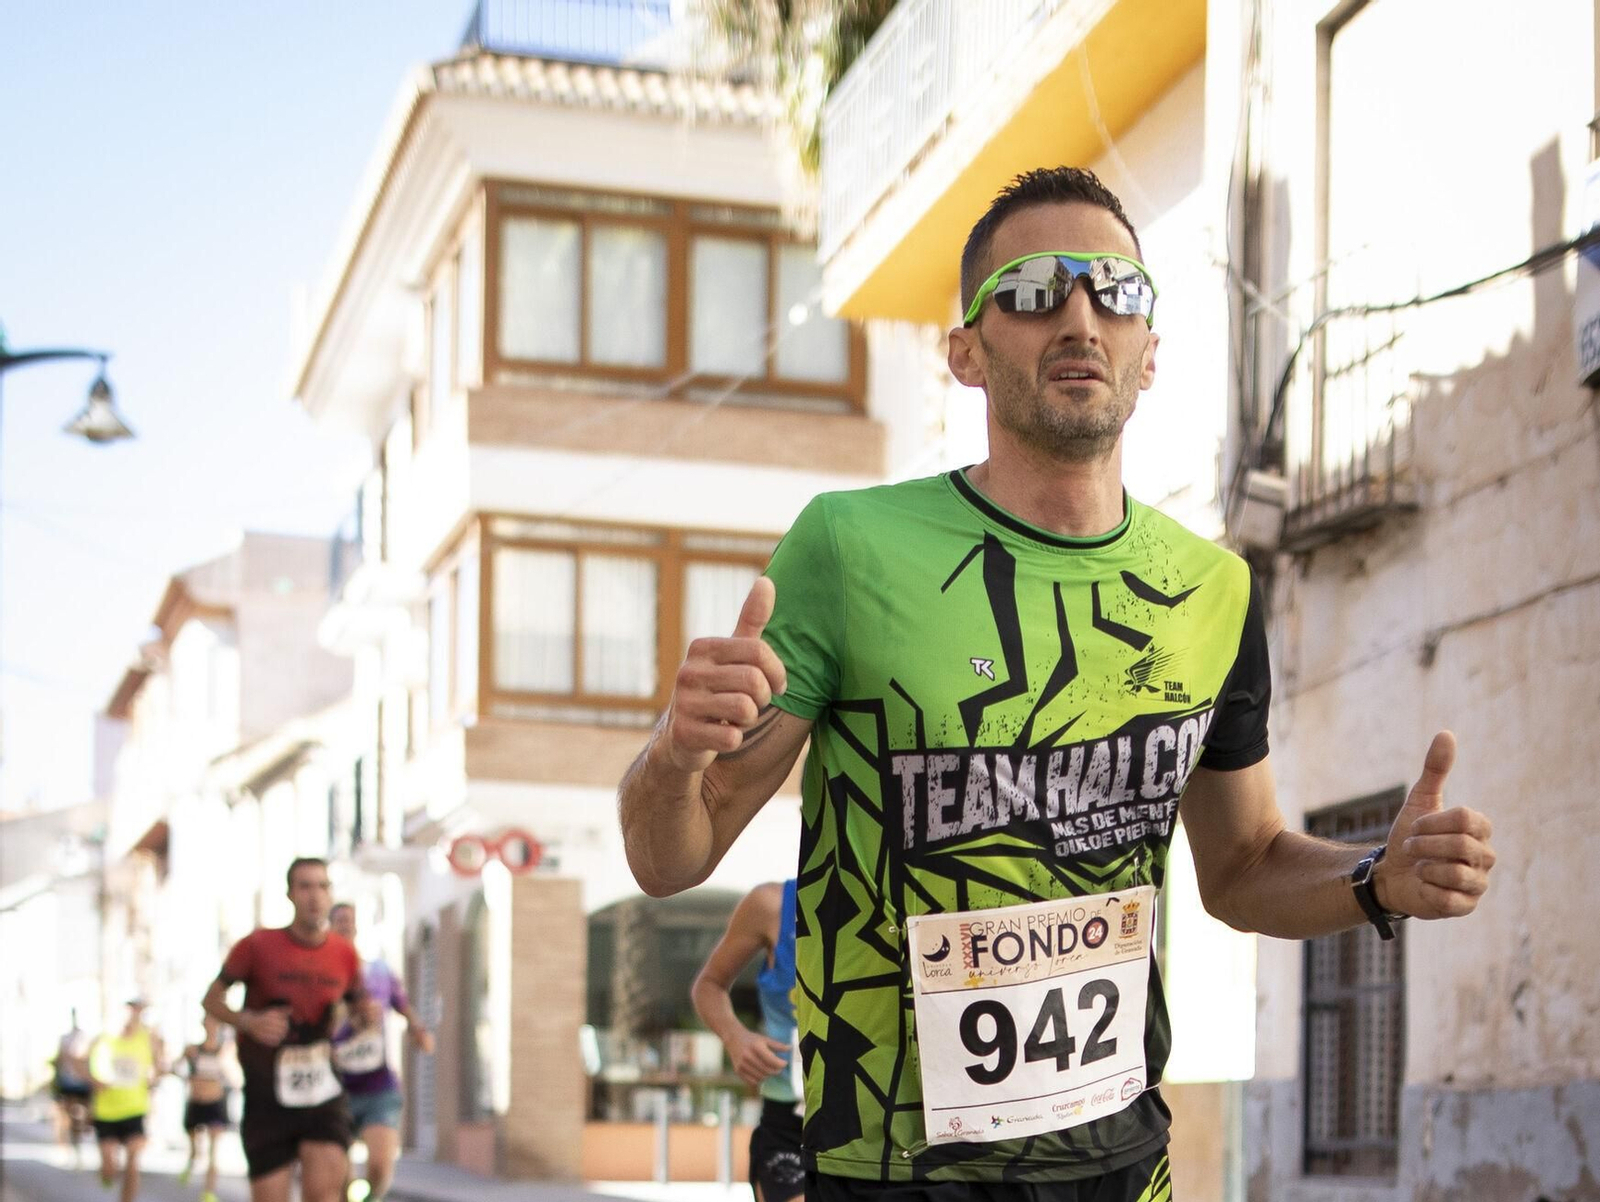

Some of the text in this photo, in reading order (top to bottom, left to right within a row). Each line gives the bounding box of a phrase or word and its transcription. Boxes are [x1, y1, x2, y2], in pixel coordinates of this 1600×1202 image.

[1163, 681, 1183, 691] TEAM
[892, 753, 1040, 849] TEAM
[1091, 809, 1117, 830] DE
[969, 917, 1021, 937] GRAN
[1027, 907, 1086, 929] PREMIO
[1088, 923, 1104, 941] 24
[970, 915, 1109, 969] FONDO
[959, 978, 1120, 1086] 942
